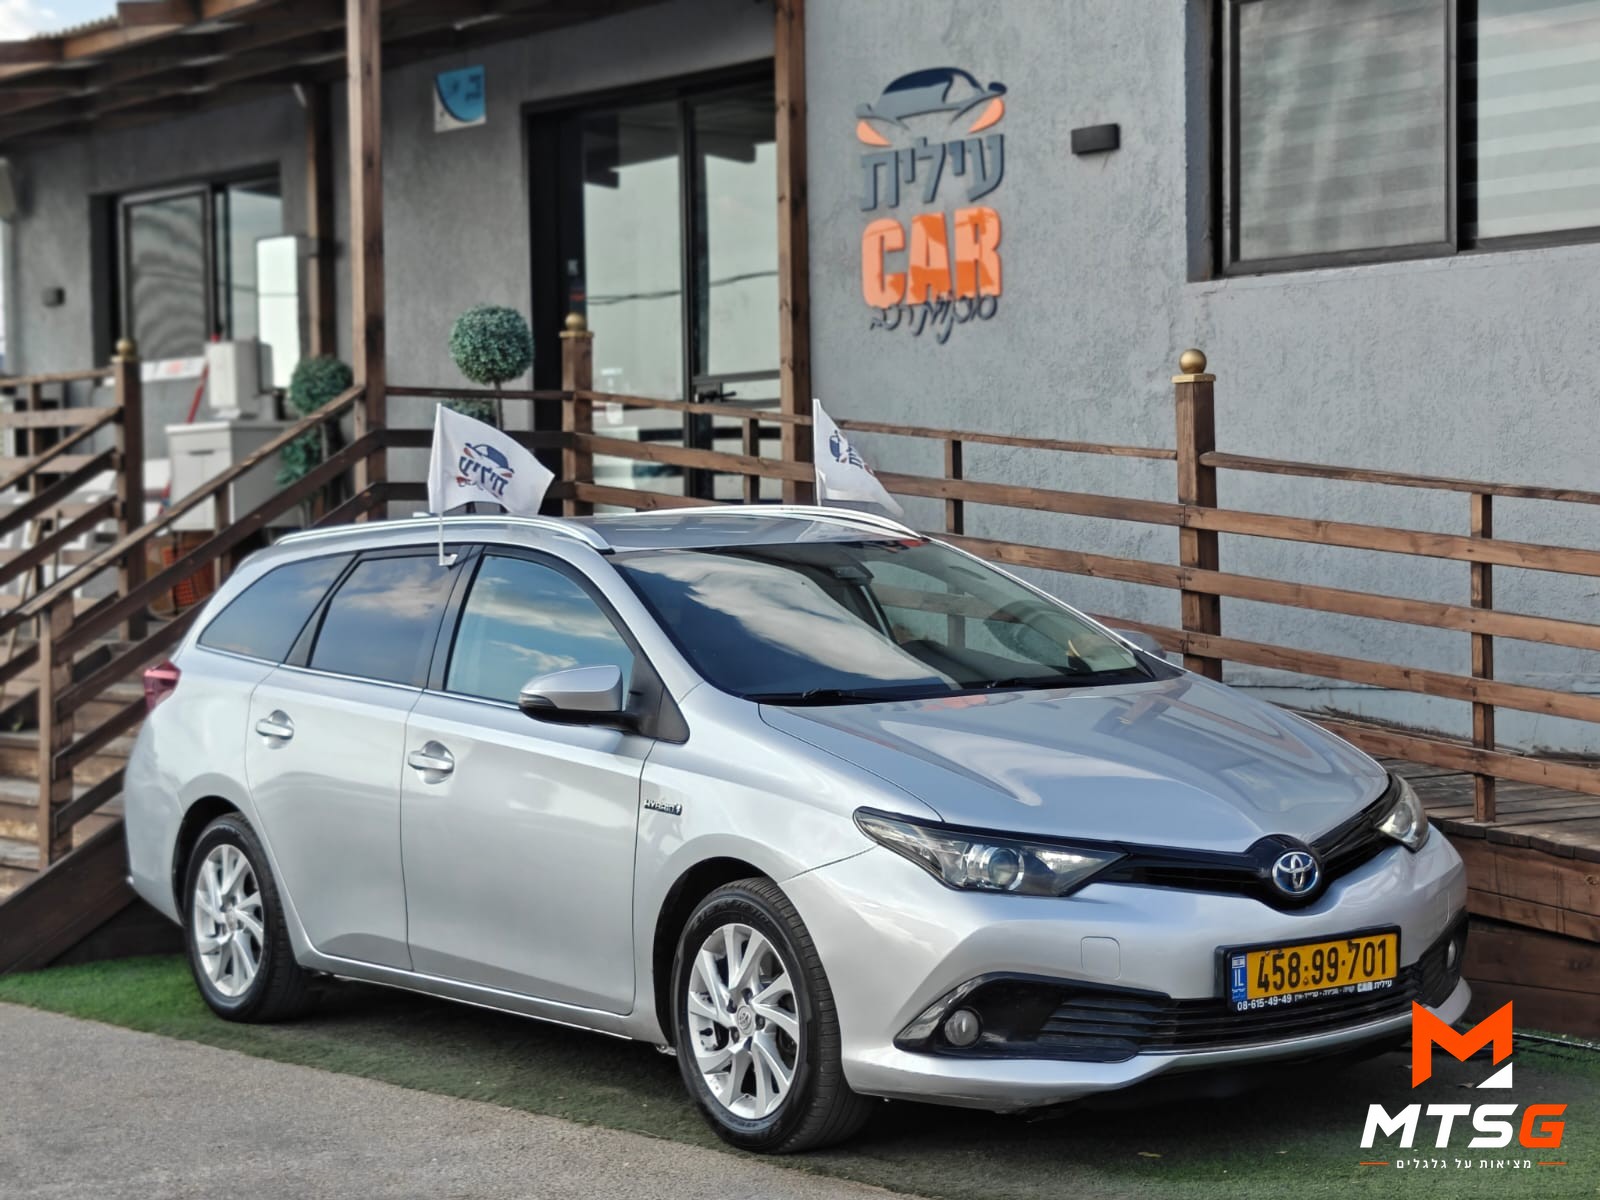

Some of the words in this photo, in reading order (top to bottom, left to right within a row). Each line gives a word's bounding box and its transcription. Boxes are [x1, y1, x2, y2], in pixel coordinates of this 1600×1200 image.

[860, 133, 1004, 212] עילית
[861, 205, 1002, 309] CAR
[1234, 968, 1244, 988] IL
[1237, 994, 1292, 1011] 08-615-49-49
